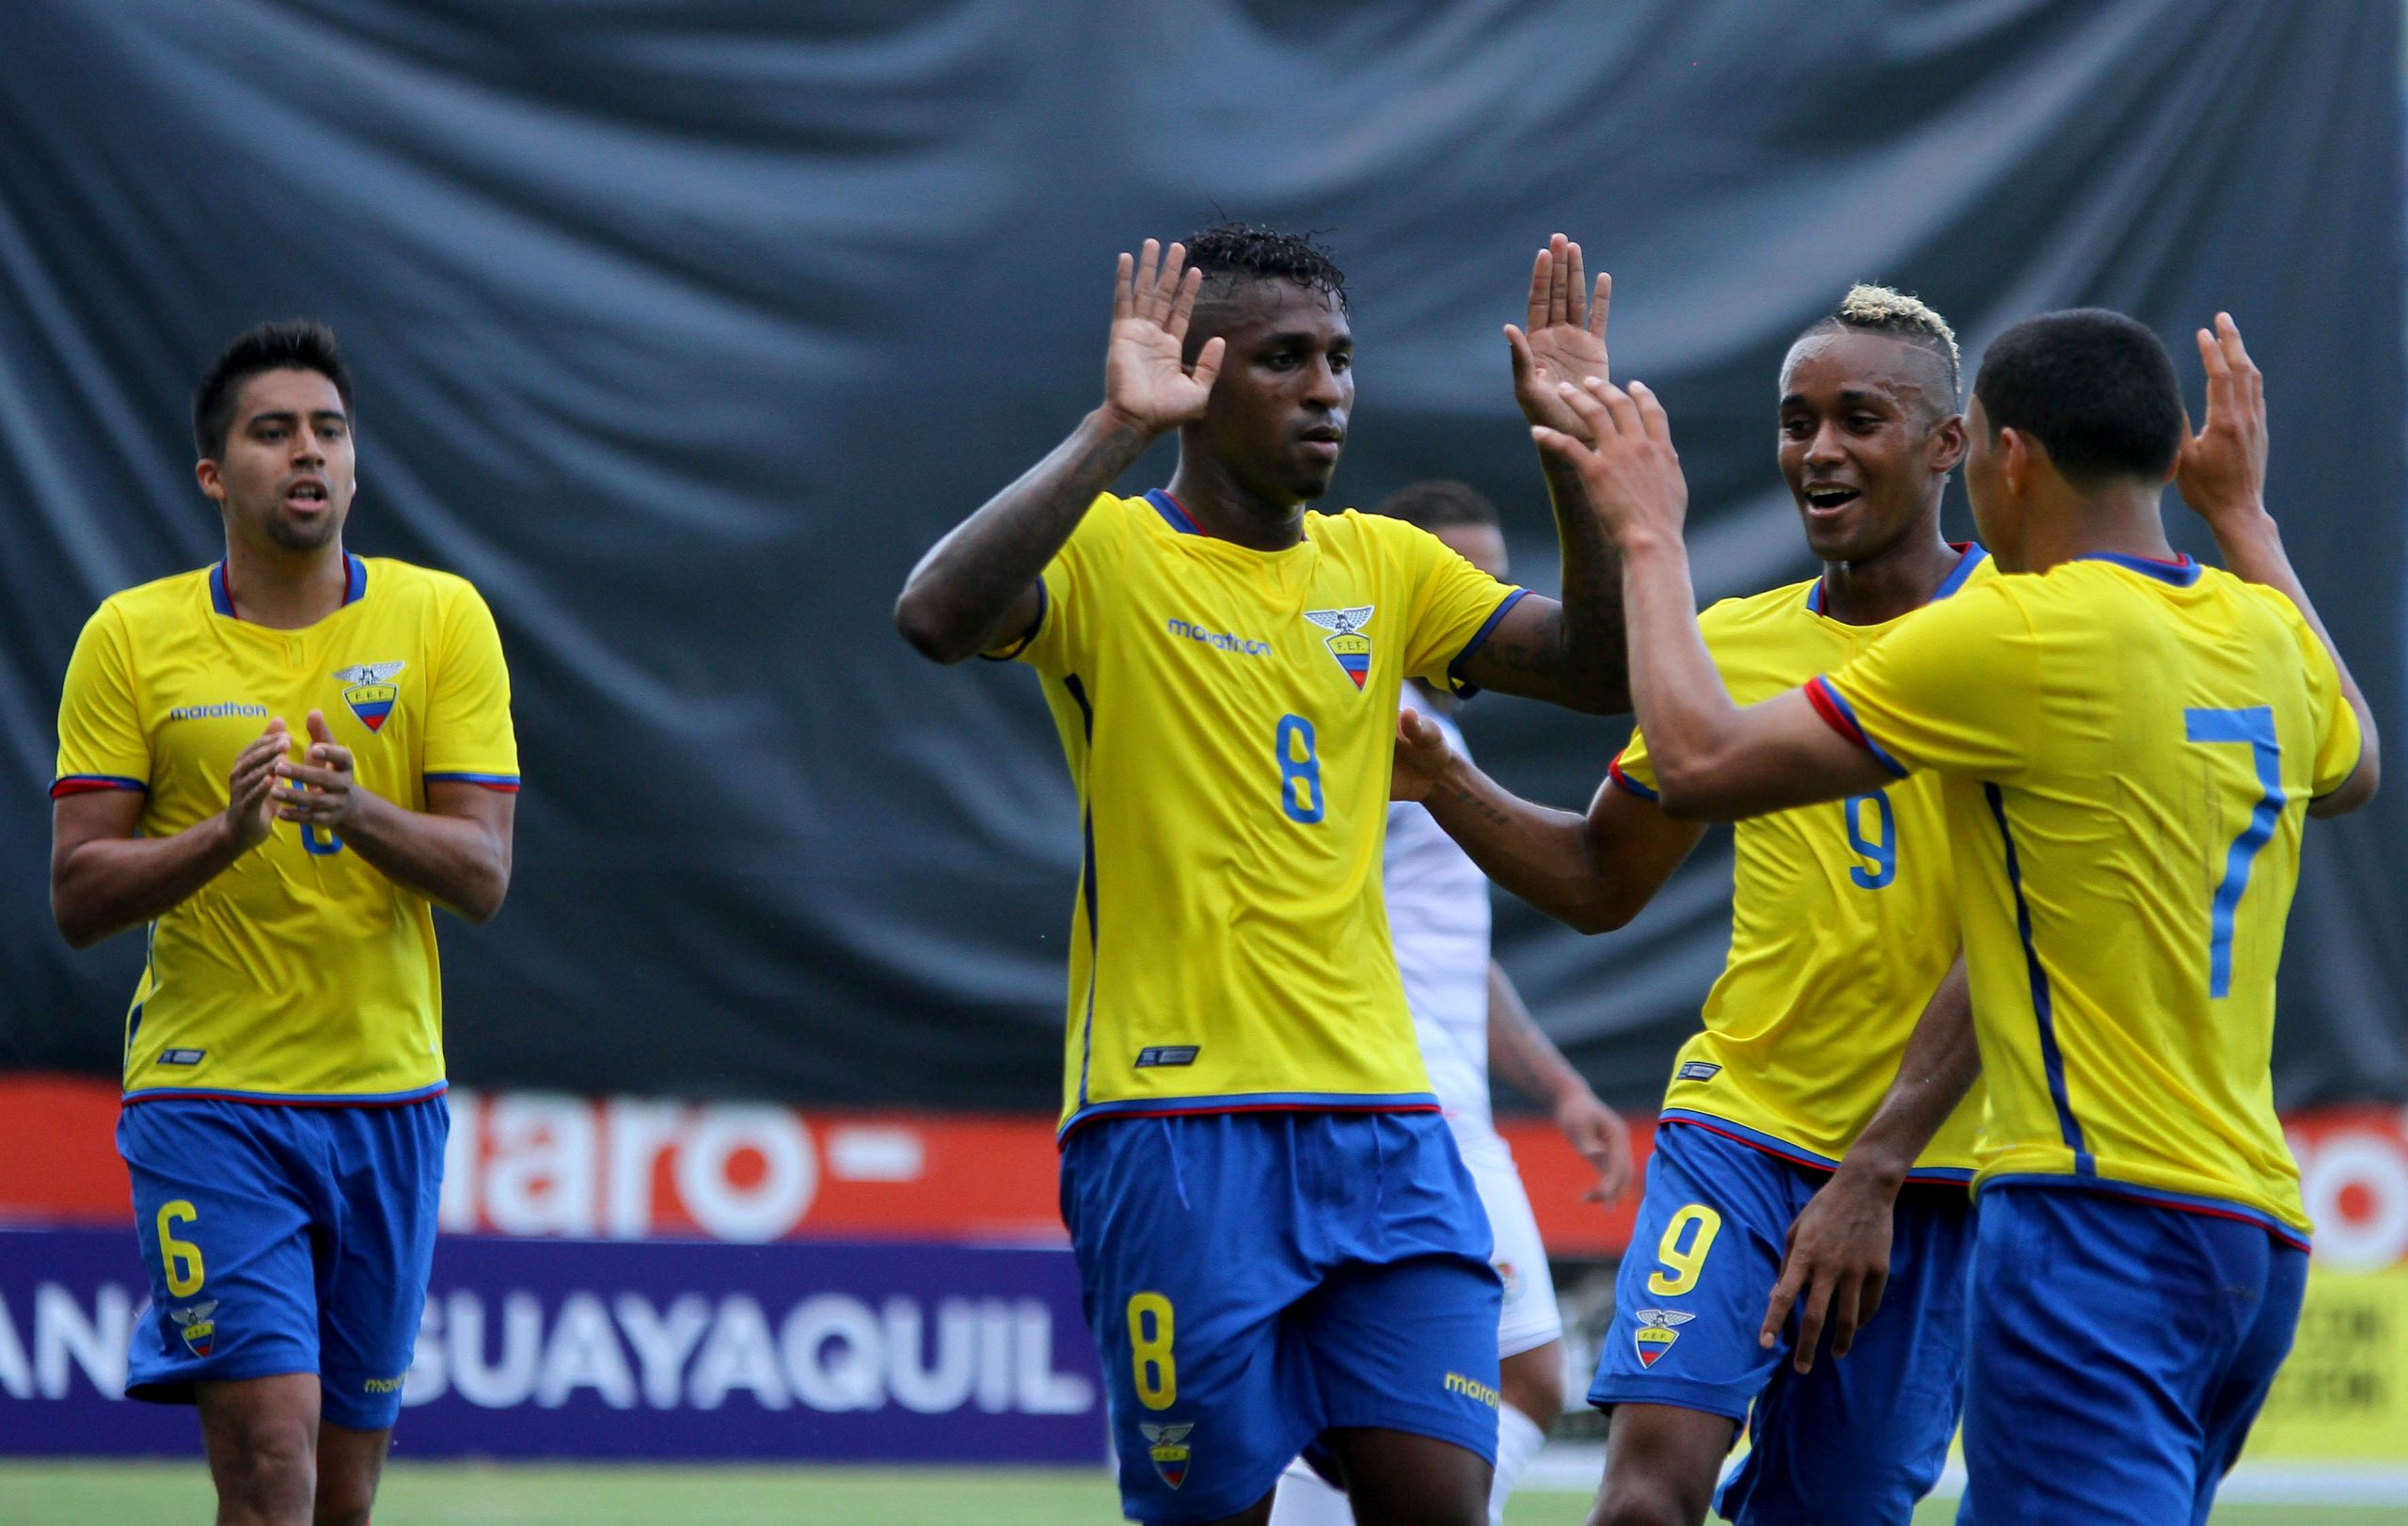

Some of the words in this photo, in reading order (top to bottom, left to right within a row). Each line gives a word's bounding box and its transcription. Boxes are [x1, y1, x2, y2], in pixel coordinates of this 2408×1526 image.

[170, 701, 267, 721] marathon
[1275, 713, 1324, 824] 8
[1845, 788, 1896, 890] 9
[2183, 705, 2287, 999] 7
[156, 1200, 205, 1298] 6
[1647, 1204, 1722, 1296] 9
[1127, 1292, 1177, 1411] 8
